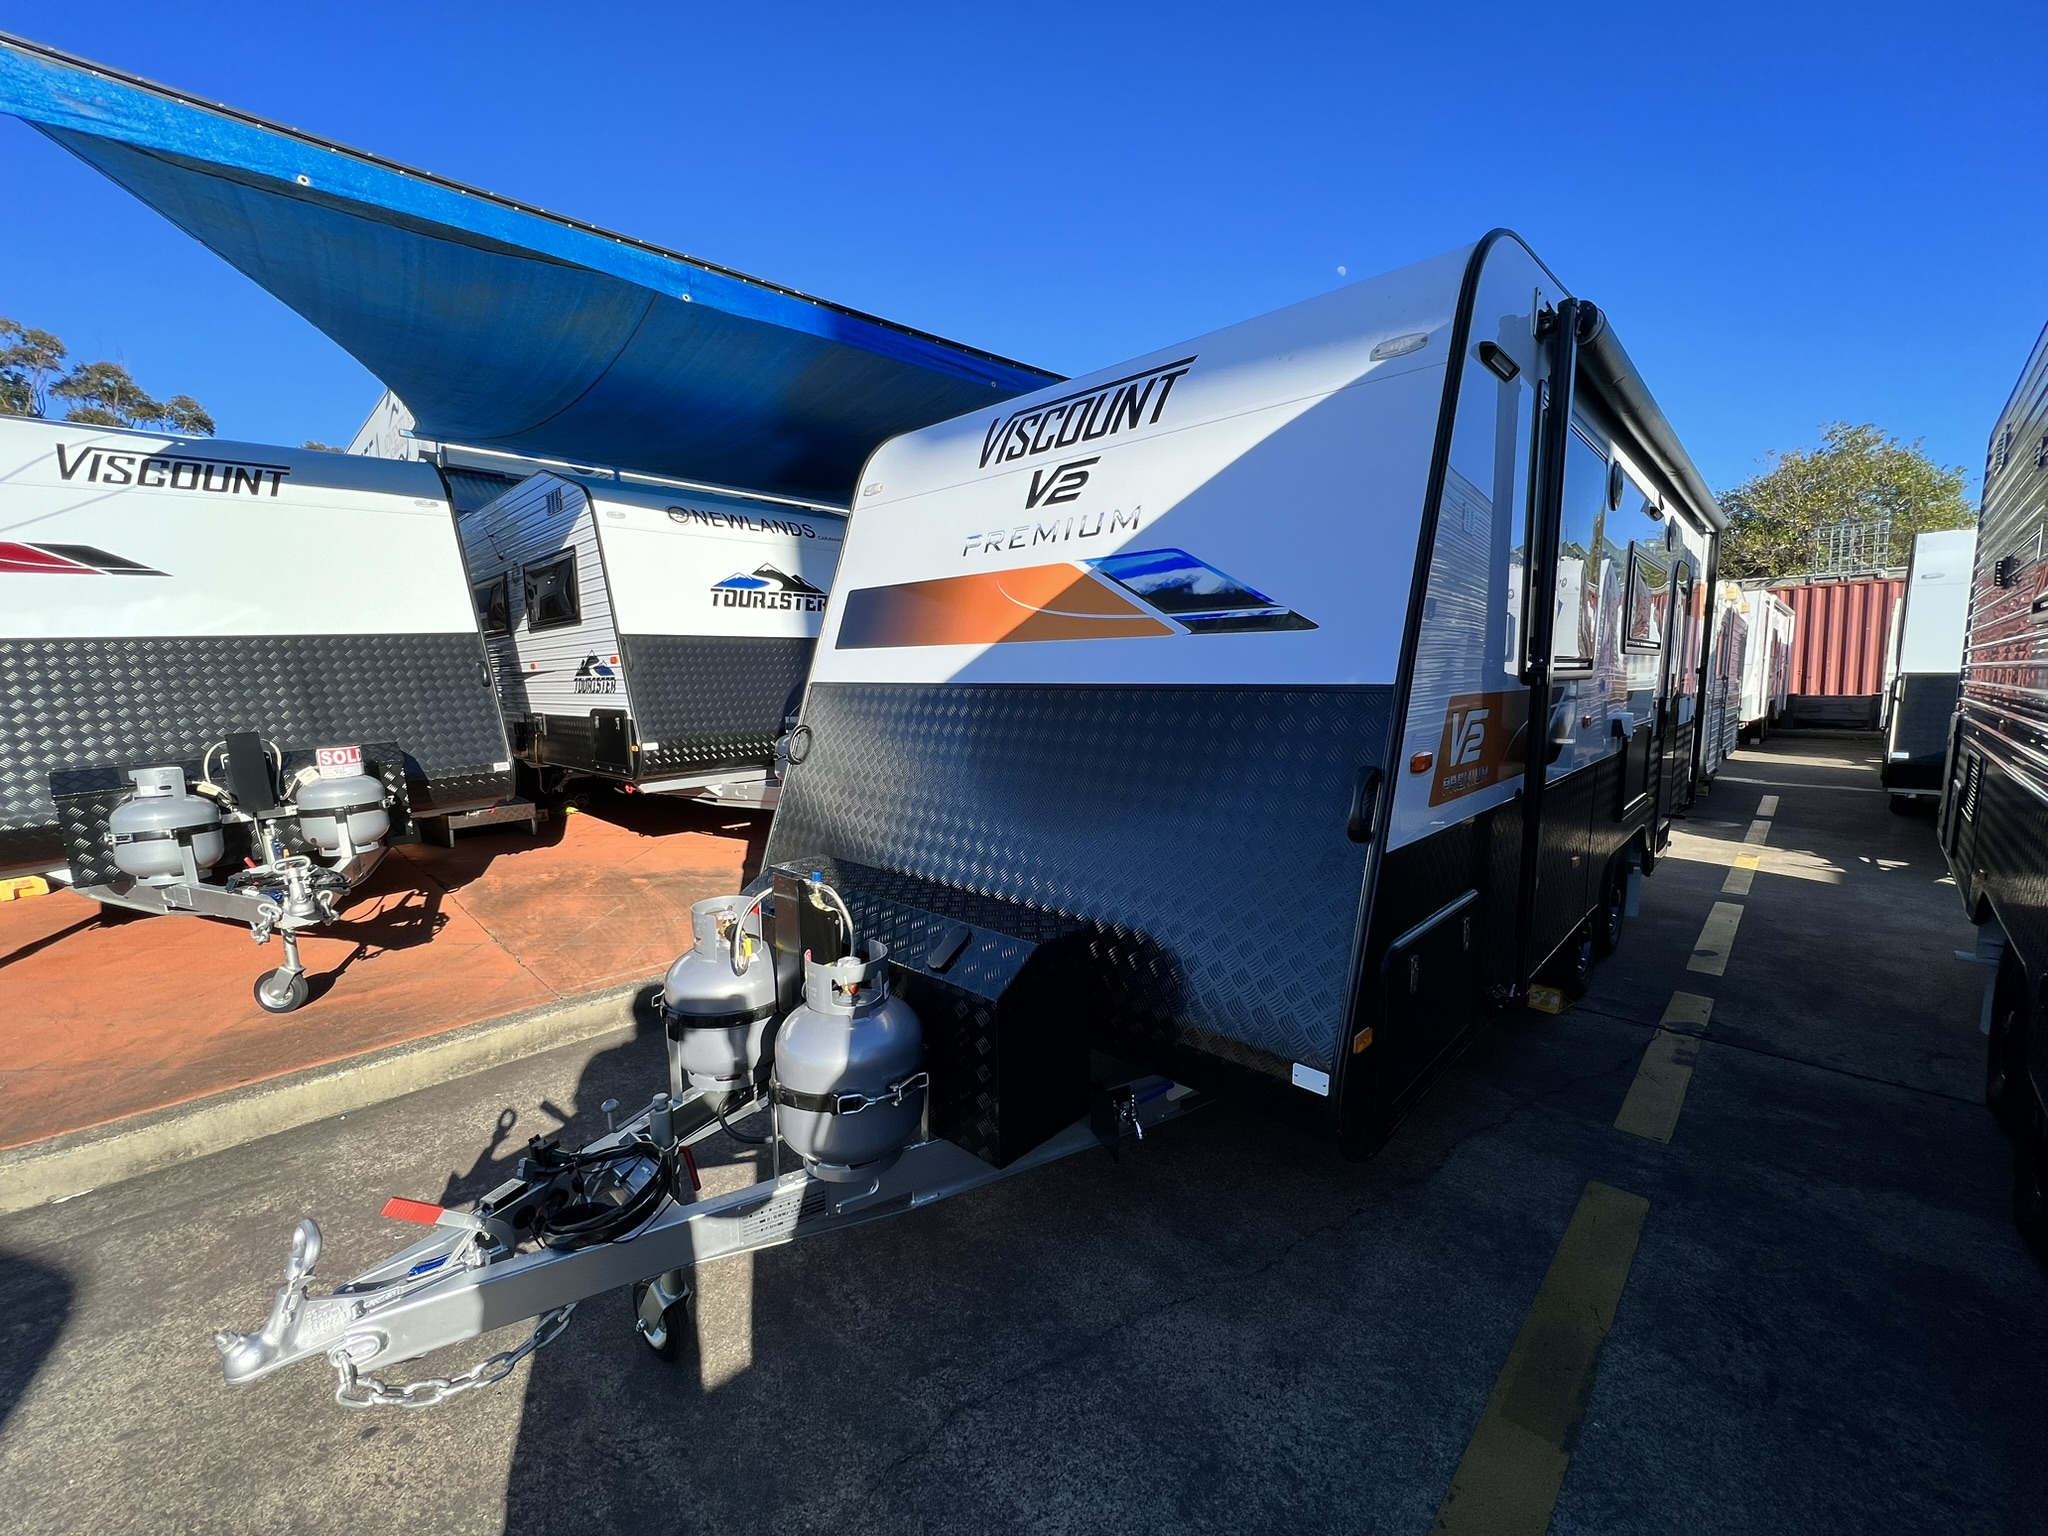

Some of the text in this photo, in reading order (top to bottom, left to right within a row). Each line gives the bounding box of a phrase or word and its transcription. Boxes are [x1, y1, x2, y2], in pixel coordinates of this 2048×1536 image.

[979, 355, 1198, 469] VISCOUNT
[56, 443, 291, 497] VISCOUNT
[1025, 456, 1101, 510] V2
[691, 509, 816, 539] NEWLANDS
[963, 505, 1141, 557] PREMIUM
[573, 677, 616, 694] TOURISTER
[1450, 708, 1489, 768] V2
[1442, 764, 1489, 796] PREMIUM
